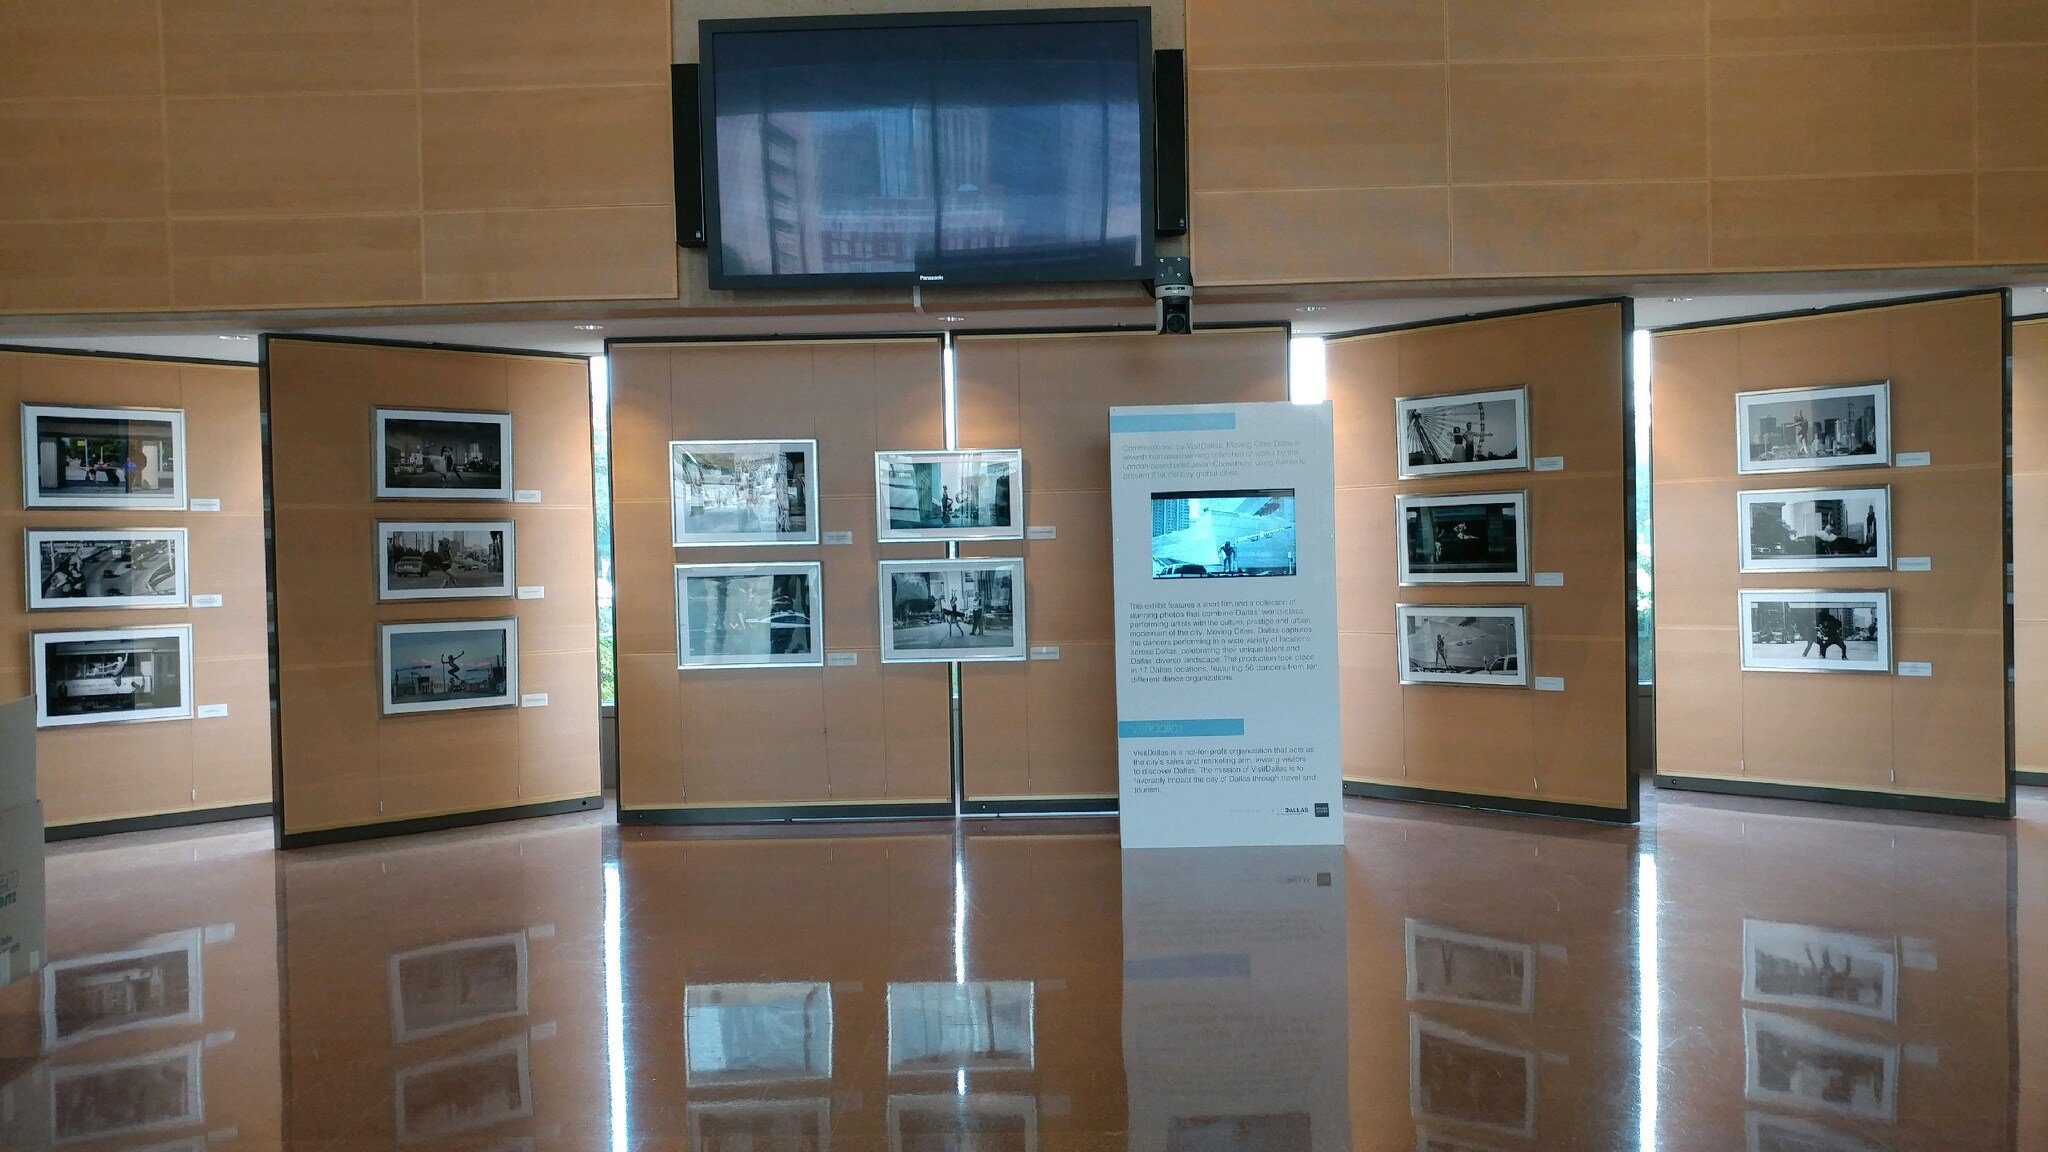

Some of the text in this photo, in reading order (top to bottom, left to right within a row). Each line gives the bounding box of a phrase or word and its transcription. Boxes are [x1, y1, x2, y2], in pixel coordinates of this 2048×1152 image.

[1160, 612, 1184, 620] photos
[1202, 610, 1234, 618] combine
[1130, 621, 1168, 630] performing
[1247, 618, 1274, 626] prestige
[1206, 628, 1232, 636] Moving
[1281, 626, 1312, 634] captures
[1173, 638, 1212, 646] performing
[1246, 636, 1268, 644] variety
[1181, 646, 1220, 656] celebrating
[1238, 655, 1276, 664] production
[1210, 664, 1244, 672] featuring
[1185, 748, 1228, 756] not-for-profit
[1229, 748, 1272, 756] organization
[1202, 758, 1236, 766] marketing
[1134, 777, 1166, 786] favorably
[1252, 774, 1280, 782] through
